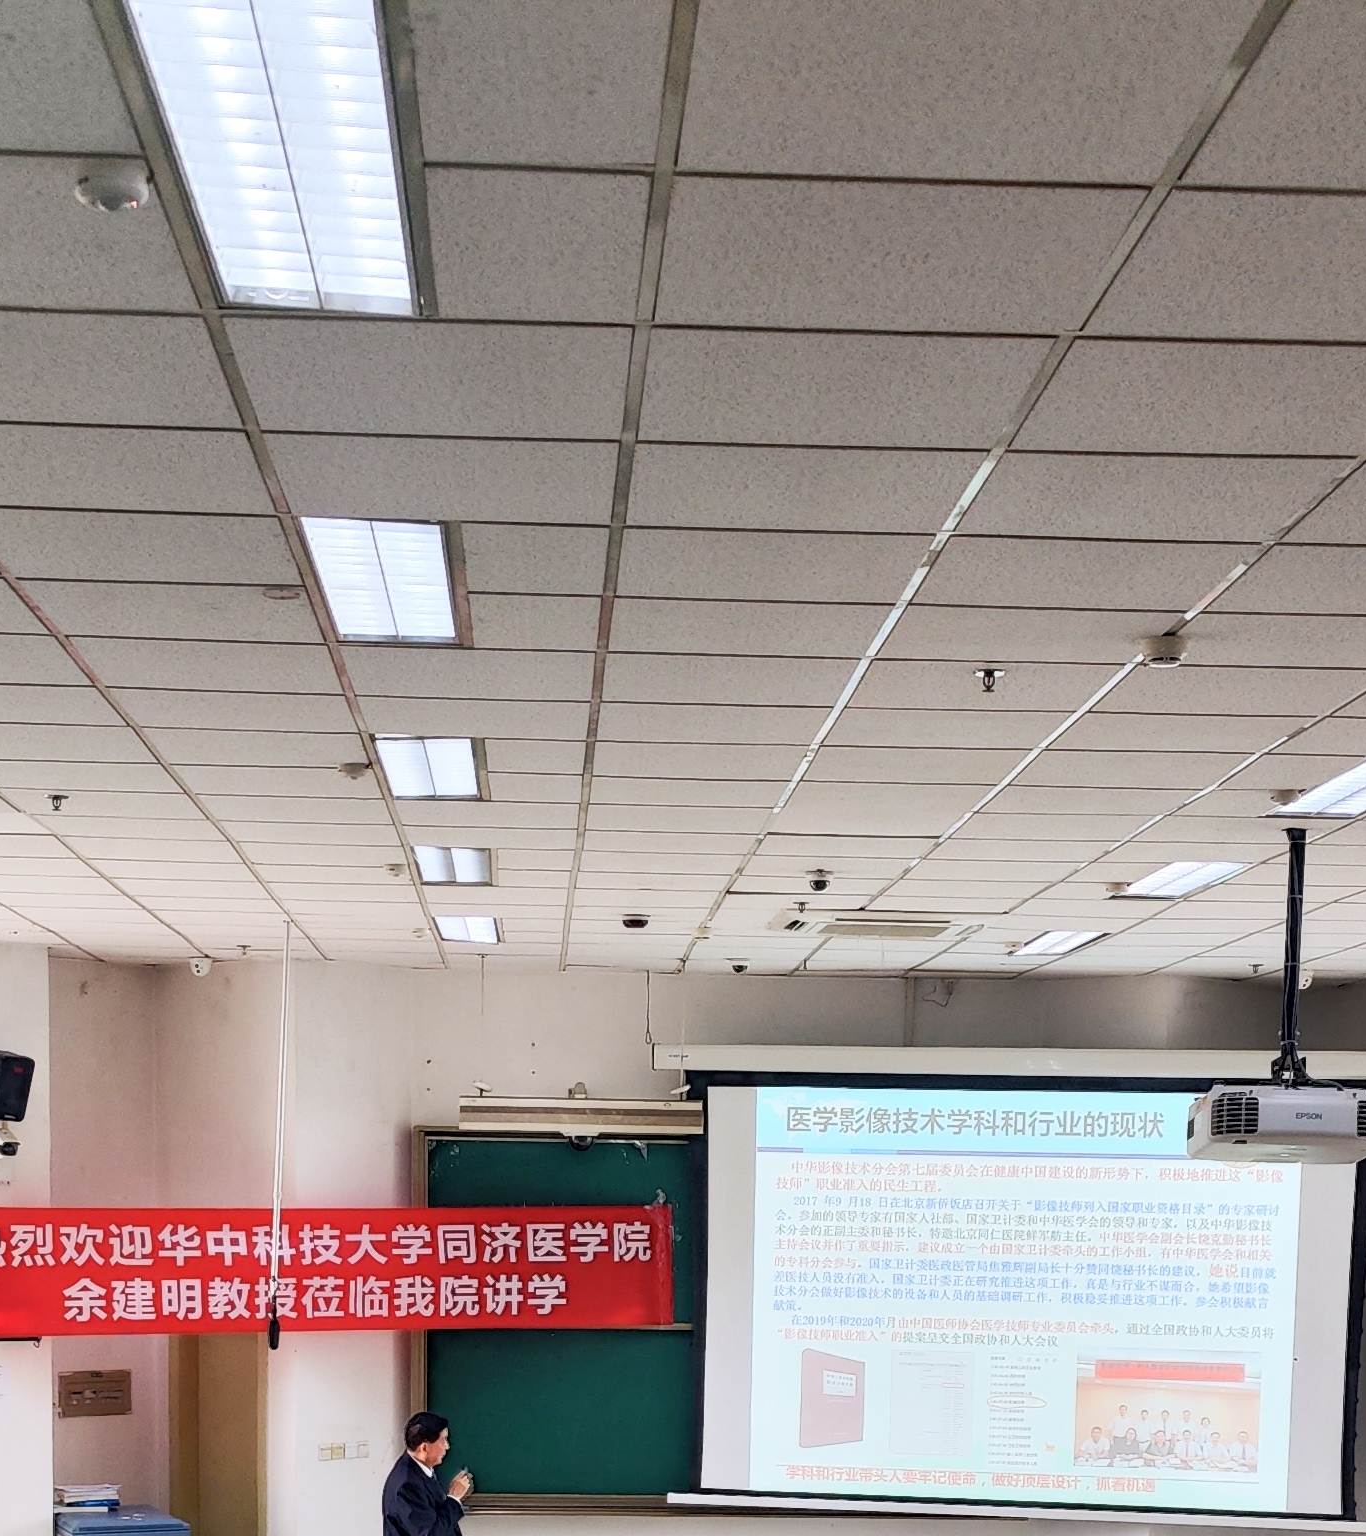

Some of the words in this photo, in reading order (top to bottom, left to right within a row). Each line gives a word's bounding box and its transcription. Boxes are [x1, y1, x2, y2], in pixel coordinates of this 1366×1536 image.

[786, 1105, 1165, 1140] 医学影像技术学科和行业的现状
[1295, 1112, 1323, 1120] EPSON
[63, 1275, 568, 1321] 余建明教授莅临我院讲学
